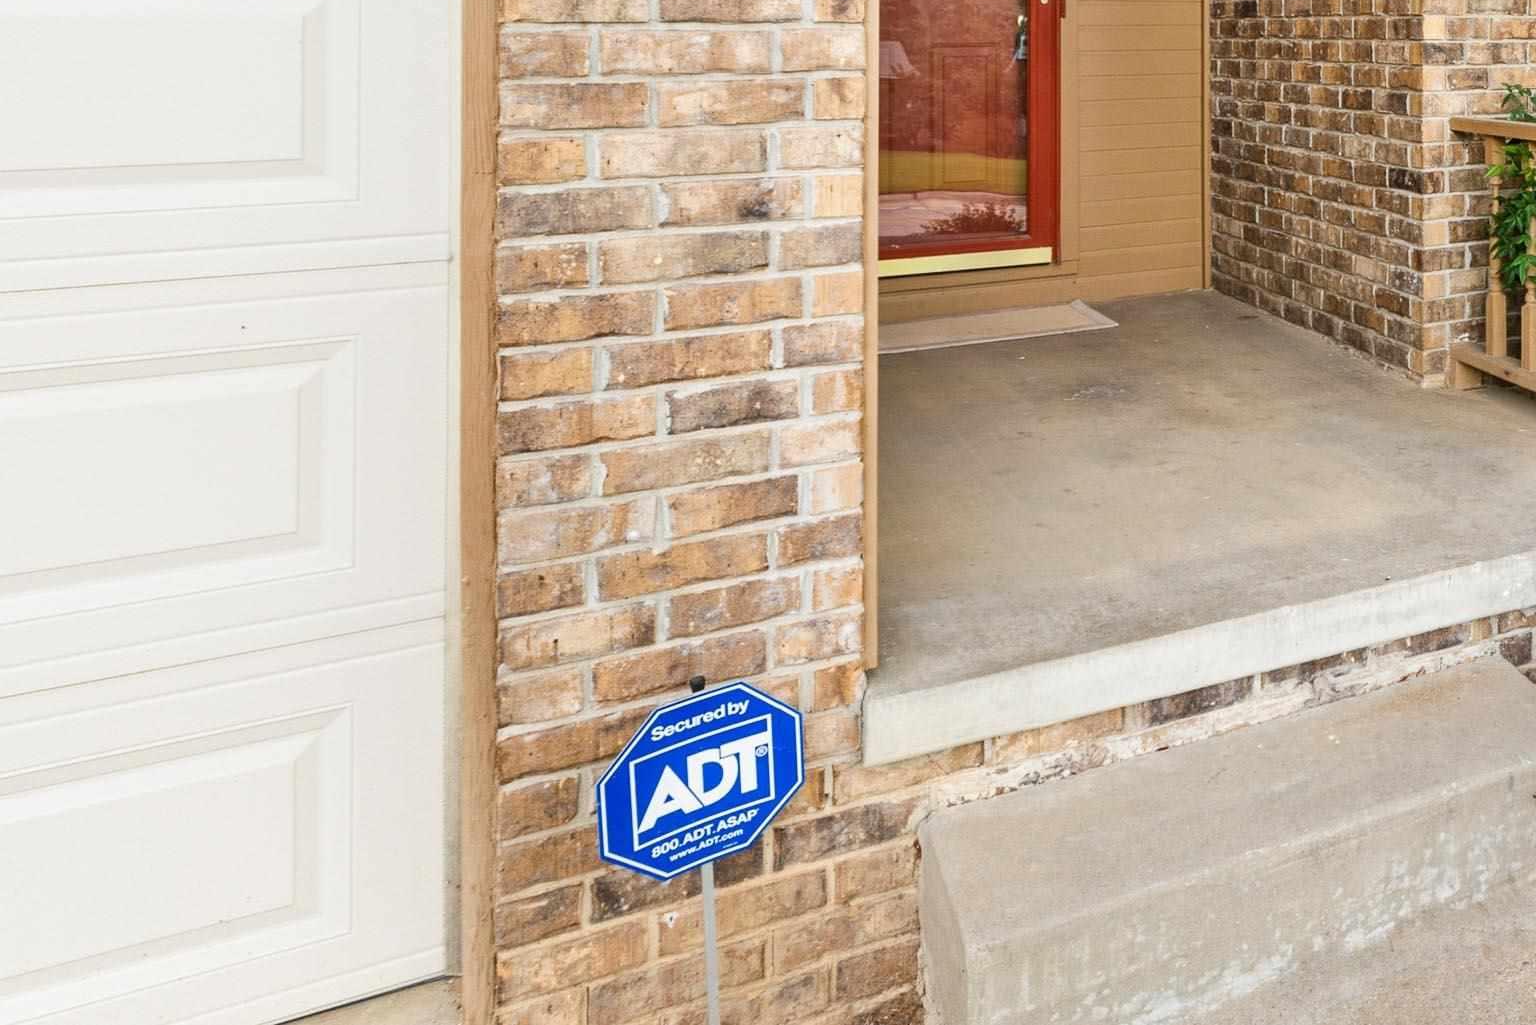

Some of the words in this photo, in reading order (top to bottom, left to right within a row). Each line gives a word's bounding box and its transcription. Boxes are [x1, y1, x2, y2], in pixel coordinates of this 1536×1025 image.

[651, 701, 726, 742] Secured
[728, 699, 750, 717] by
[637, 730, 769, 833] ADT
[651, 808, 759, 859] 800.ADT.ASAP
[669, 828, 744, 862] www.ADT.com
